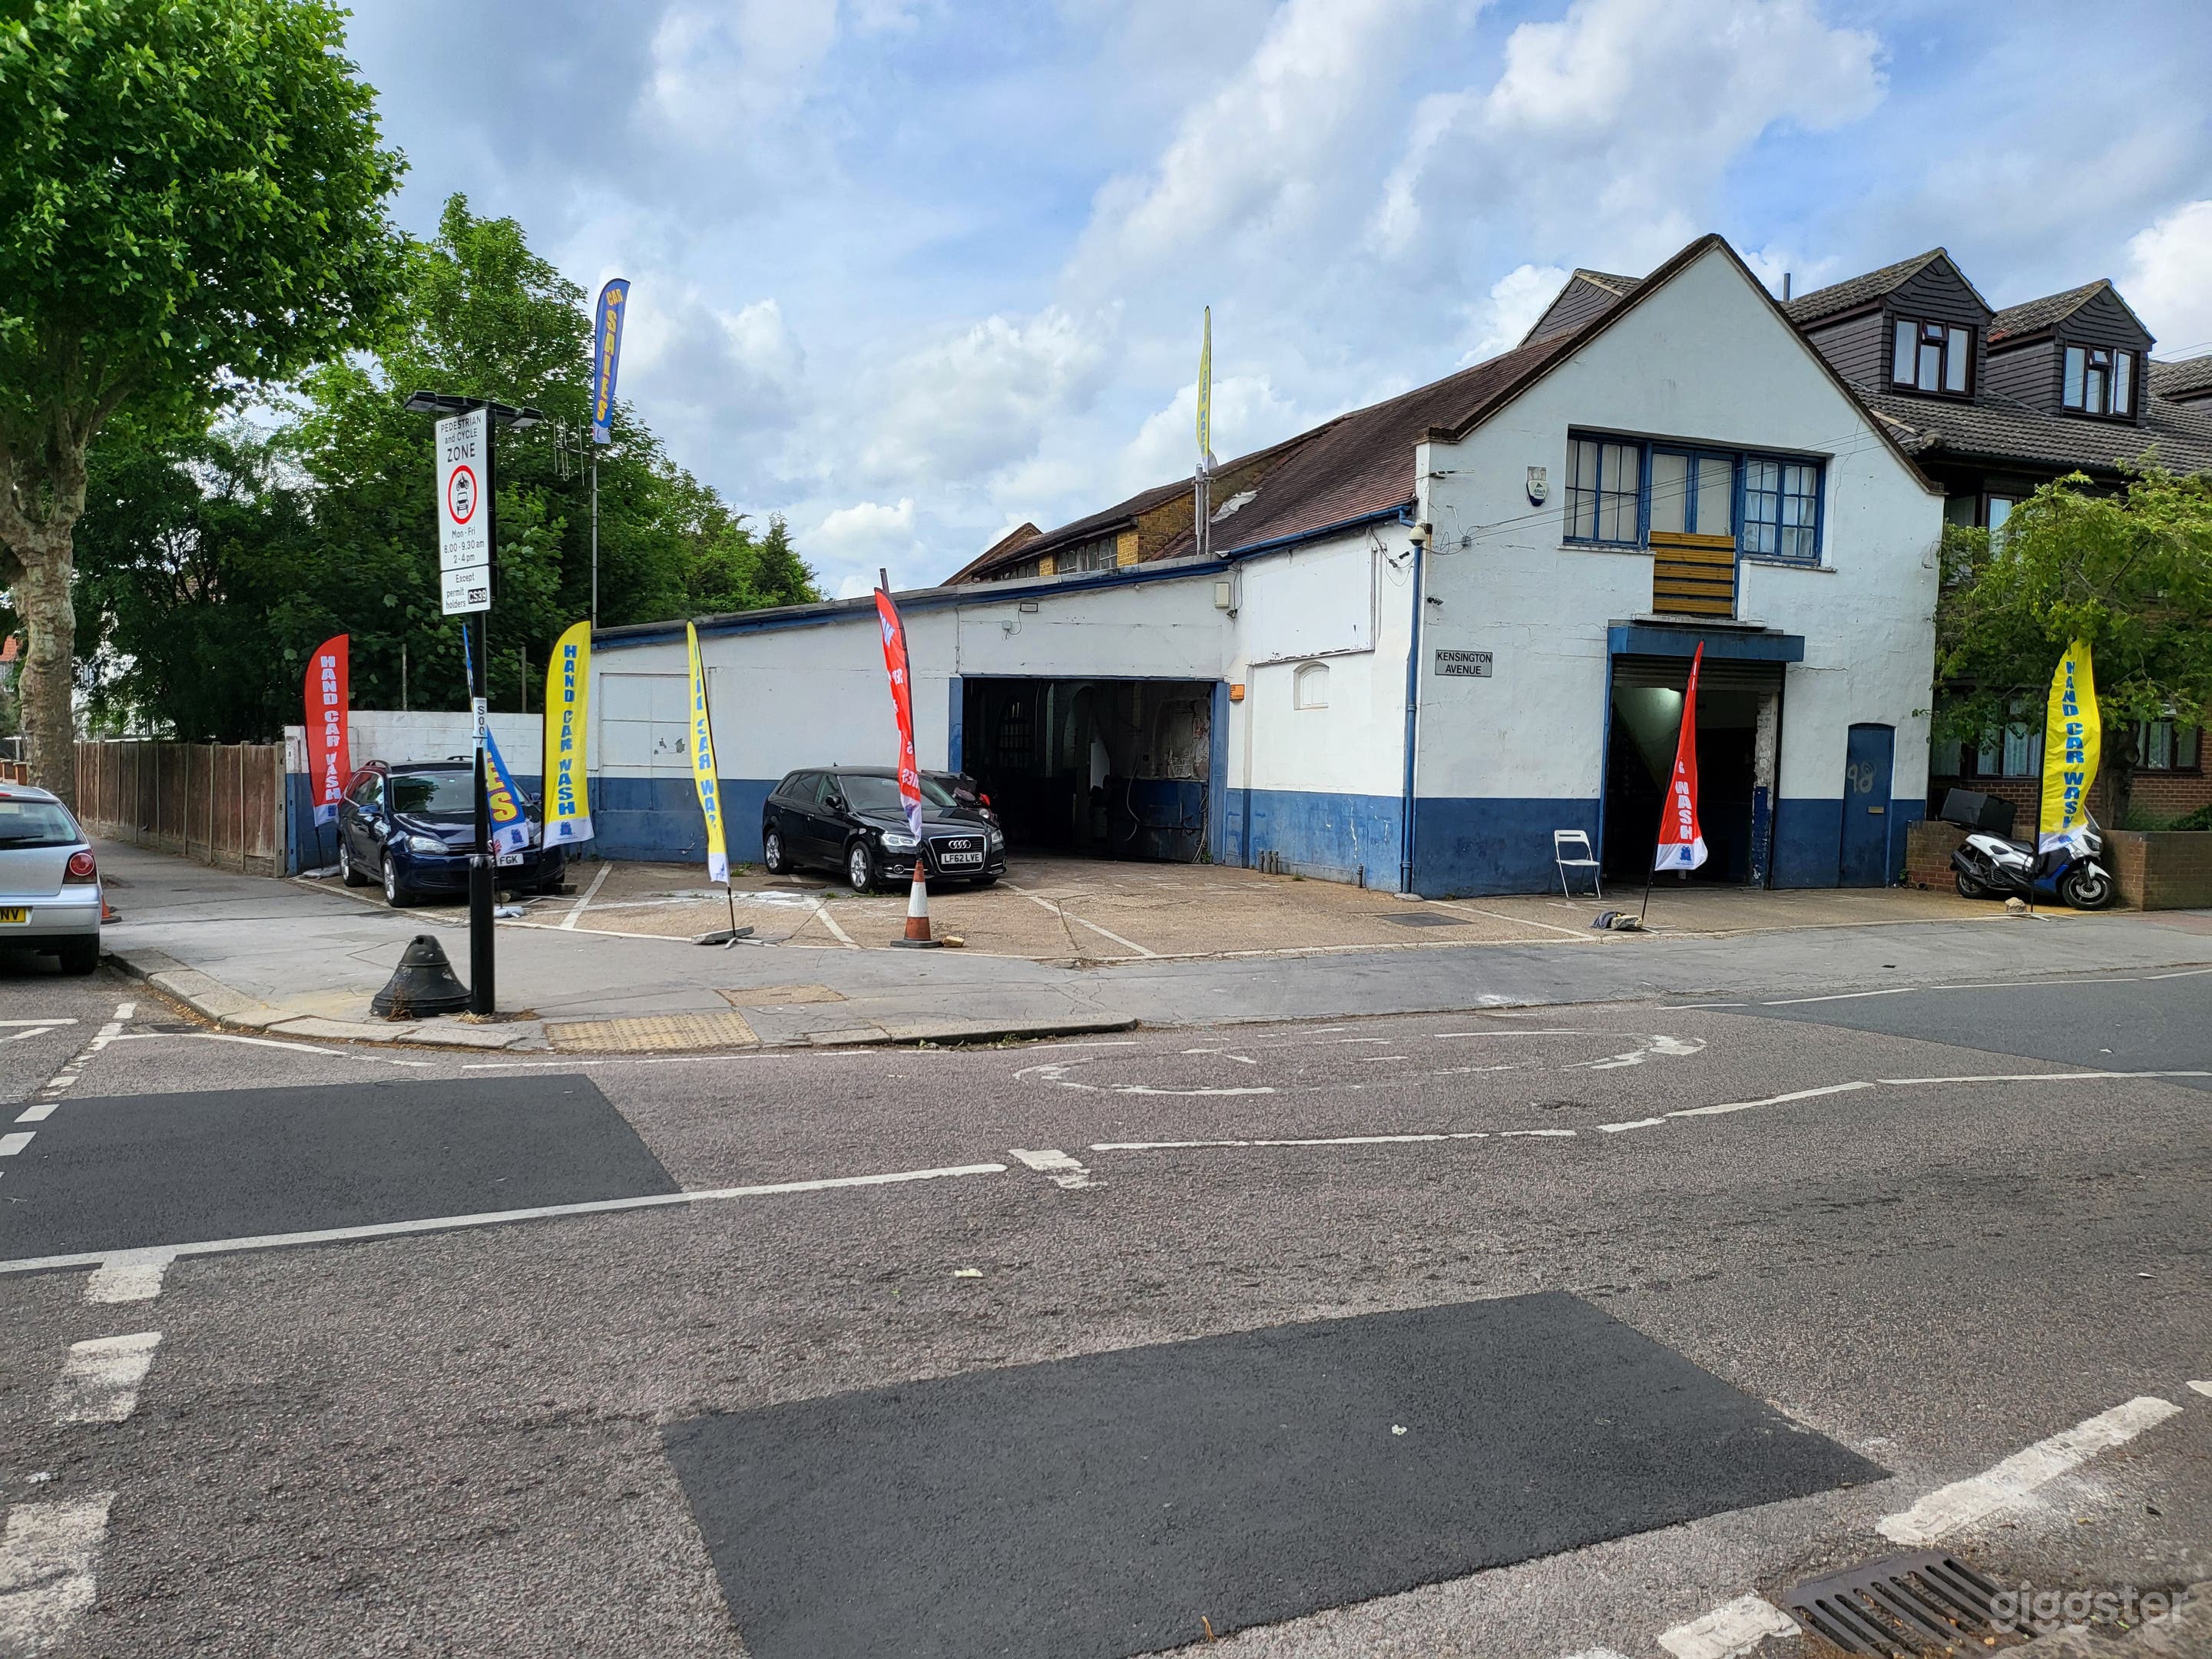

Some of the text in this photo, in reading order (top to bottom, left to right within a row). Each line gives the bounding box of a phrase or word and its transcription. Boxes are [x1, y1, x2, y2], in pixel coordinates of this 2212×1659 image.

[606, 288, 623, 306] CAR
[597, 310, 617, 422] SALES
[441, 414, 482, 433] PEDESTRIAN
[445, 428, 478, 444] and CYCLE
[447, 442, 475, 462] ZONE
[452, 529, 464, 538] Mon
[468, 527, 476, 536] Fri
[476, 540, 485, 548] am
[467, 554, 475, 563] pm
[455, 572, 475, 583] Except
[446, 588, 465, 598] permit
[469, 590, 487, 603] CS39
[446, 600, 466, 609] holders
[1437, 651, 1492, 663] KENSINGTON
[1445, 664, 1482, 674] AVENUE
[320, 656, 338, 705] HAND
[325, 710, 340, 747] CAR
[558, 645, 577, 816] HAND CAR WASH
[2065, 722, 2085, 763] CAR
[1675, 780, 1693, 840] WASH
[944, 853, 980, 863] LF62 LVE
